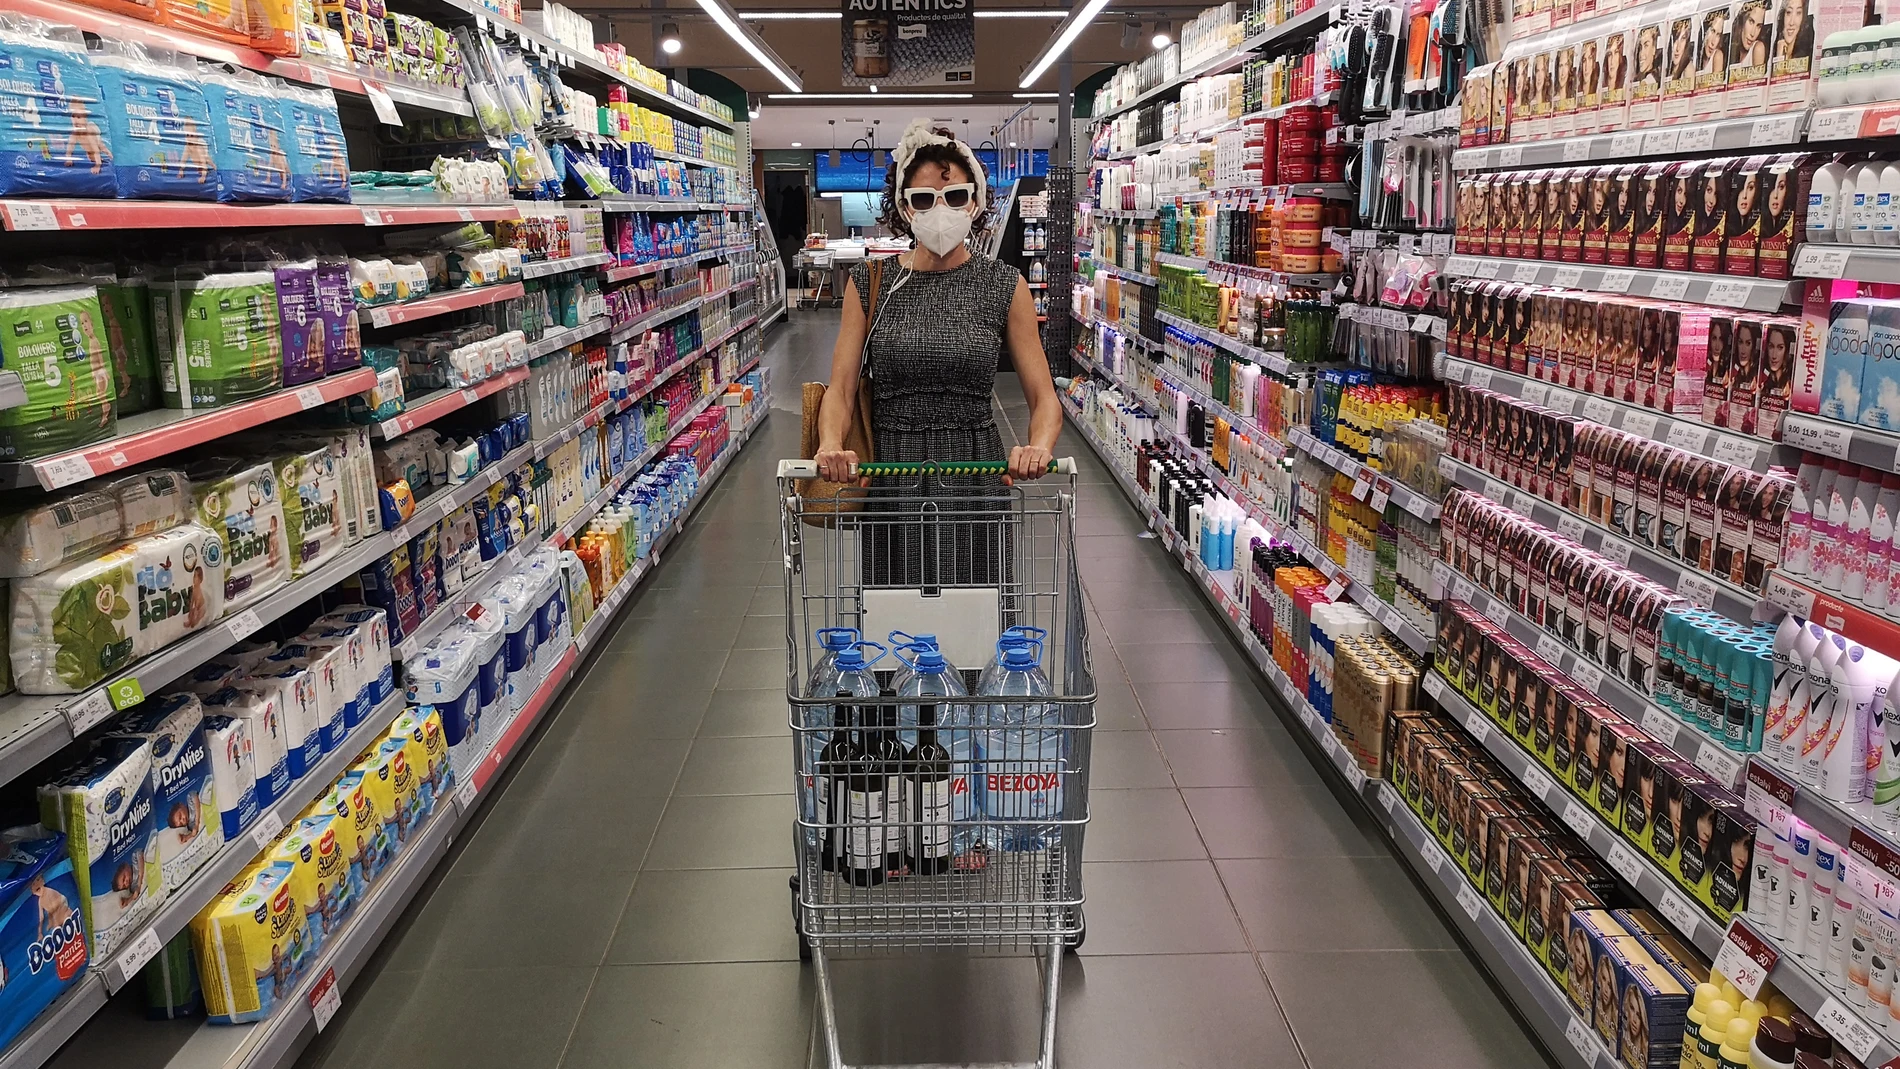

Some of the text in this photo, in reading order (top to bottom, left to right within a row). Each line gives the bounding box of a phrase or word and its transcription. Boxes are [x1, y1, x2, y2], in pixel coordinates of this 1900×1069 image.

[849, 0, 967, 11] AUTENTICS
[942, 12, 967, 20] qualitat
[24, 97, 42, 128] 4
[126, 102, 157, 117] BOLQUERS
[1610, 235, 1628, 243] INTENSIVE
[1636, 236, 1656, 244] INTENSIVE
[1666, 237, 1688, 246] INTENSIVE
[1694, 238, 1719, 248] INTENSIVE
[1728, 240, 1754, 248] INTENSIVE
[1761, 241, 1786, 250] INTENSIVE
[334, 296, 342, 317] 6
[296, 304, 306, 326] 6
[237, 328, 248, 350] 5
[1801, 320, 1815, 360] fruity
[18, 342, 56, 358] BOLQUERS
[22, 361, 40, 372] TALLA
[44, 356, 62, 387] 5
[1804, 337, 1817, 394] rhythm
[1762, 396, 1784, 408] GARNIER
[1788, 425, 1800, 434] 9,00
[1664, 488, 1685, 503] casting
[1692, 498, 1714, 514] casting
[304, 503, 334, 532] Baby
[1723, 508, 1748, 526] casting
[1754, 518, 1781, 536] casting
[230, 531, 271, 567] Baby
[1774, 586, 1786, 595] 1,49
[1819, 598, 1844, 613] producte
[120, 695, 140, 706] eco
[162, 746, 204, 786] DryNites
[170, 784, 179, 794] Bed
[988, 772, 1060, 793] BEZOYA
[1750, 772, 1770, 792] estalvi
[111, 798, 150, 846] DryNites
[1656, 826, 1674, 844] ADVANCE
[117, 842, 126, 853] Bed
[1852, 840, 1878, 862] estalvi
[1684, 850, 1703, 868] ADVANCE
[1715, 875, 1737, 896] ADVANCE
[27, 908, 80, 975] DODOT
[1730, 931, 1752, 953] estalvi
[59, 938, 82, 968] pants
[126, 953, 136, 966] 5,99
[1830, 1010, 1846, 1025] 3,35
[1686, 1025, 1698, 1036] ml
[1698, 1042, 1710, 1053] ml
